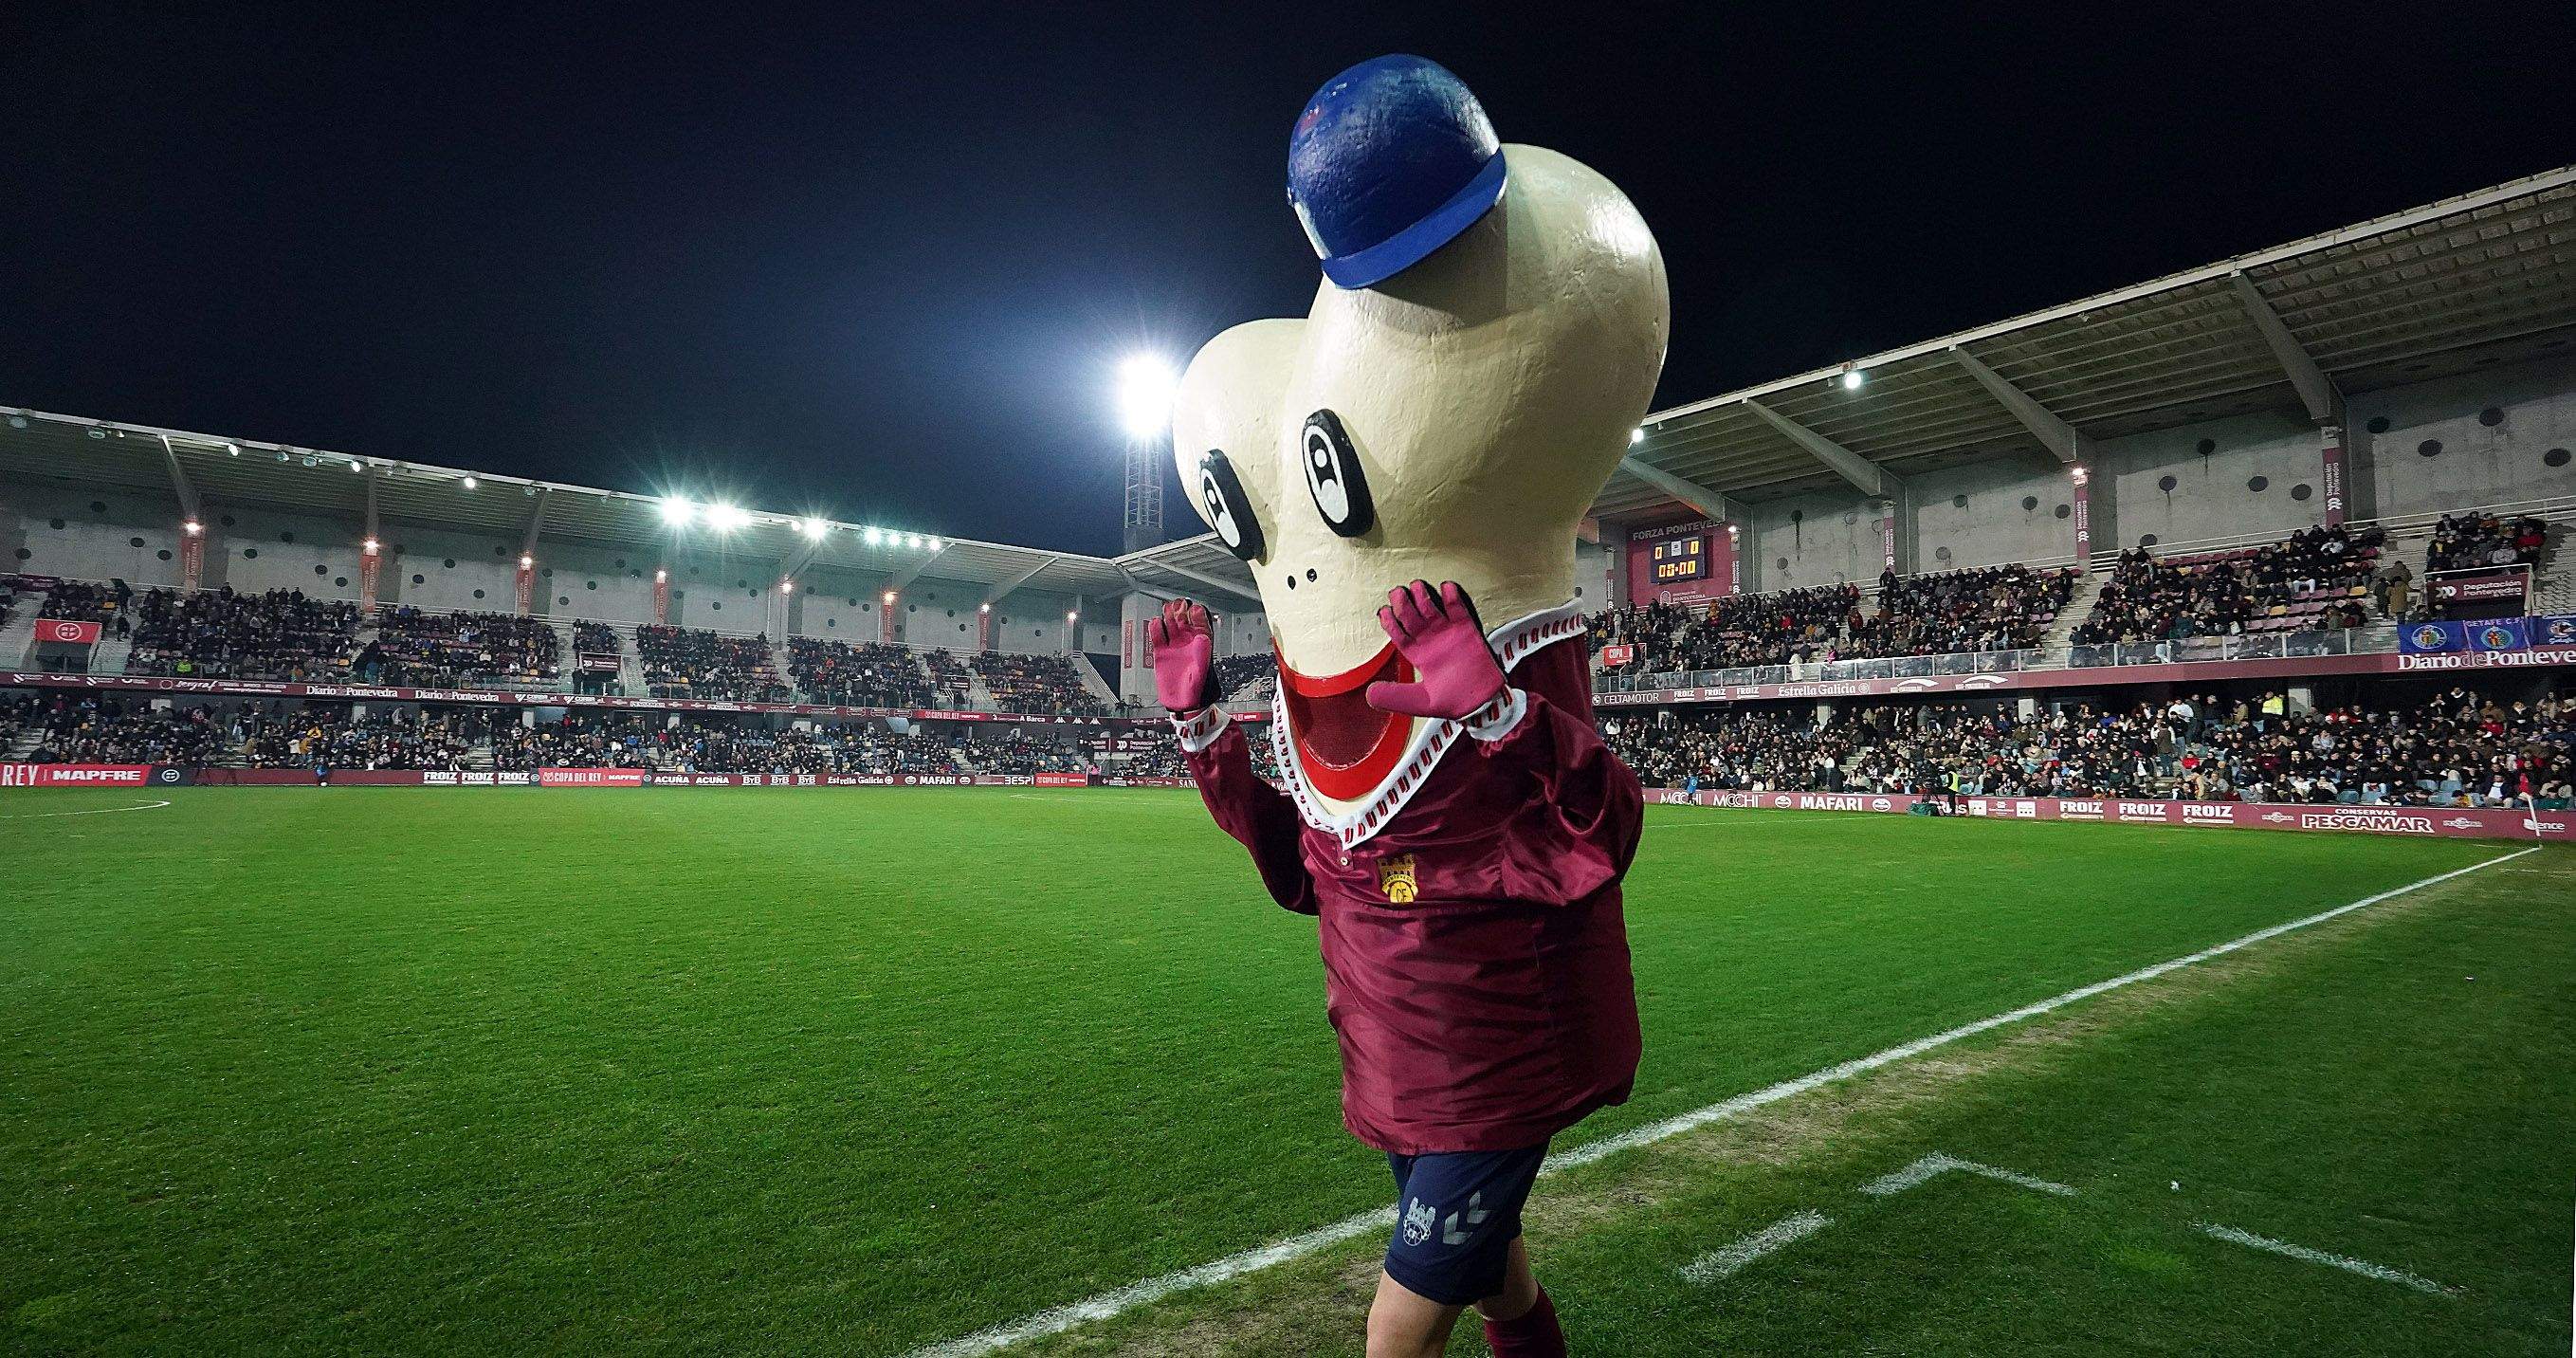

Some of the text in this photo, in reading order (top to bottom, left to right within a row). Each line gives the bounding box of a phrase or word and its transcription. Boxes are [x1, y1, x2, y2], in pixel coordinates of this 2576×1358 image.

[1633, 527, 1664, 541] FORZA
[2463, 579, 2522, 591] Deputación
[2463, 586, 2522, 596] Pontevedra
[2466, 618, 2502, 628] GETAFE
[306, 685, 337, 695] Diario
[346, 687, 398, 698] Pontevedra
[415, 689, 443, 700] Diario
[451, 691, 500, 702] Pontevedra
[1604, 693, 1659, 705] CELTAMOTOR
[1705, 688, 1726, 697] FROIZ
[1737, 686, 1760, 695] FROIZ
[1778, 686, 1817, 697] Estrella
[1818, 683, 1856, 696] Galicia
[1, 764, 141, 786] REY MAPFRE
[424, 772, 458, 780] FROIZ
[462, 772, 494, 781] FROIZ
[498, 772, 530, 781] FROIZ
[554, 773, 573, 782] COPA
[575, 773, 588, 782] DEL
[589, 773, 602, 782] REY
[654, 774, 689, 783] ACUÑA
[695, 775, 730, 784] ACUÑA
[828, 776, 956, 785] Estrella Galicia MAFARI
[1801, 796, 1863, 811] MAFARI
[2059, 801, 2233, 817] FROIZ FROIZ FROIZ
[2334, 808, 2397, 817] CONSERVAS
[2301, 814, 2435, 834] PESCAMAR
